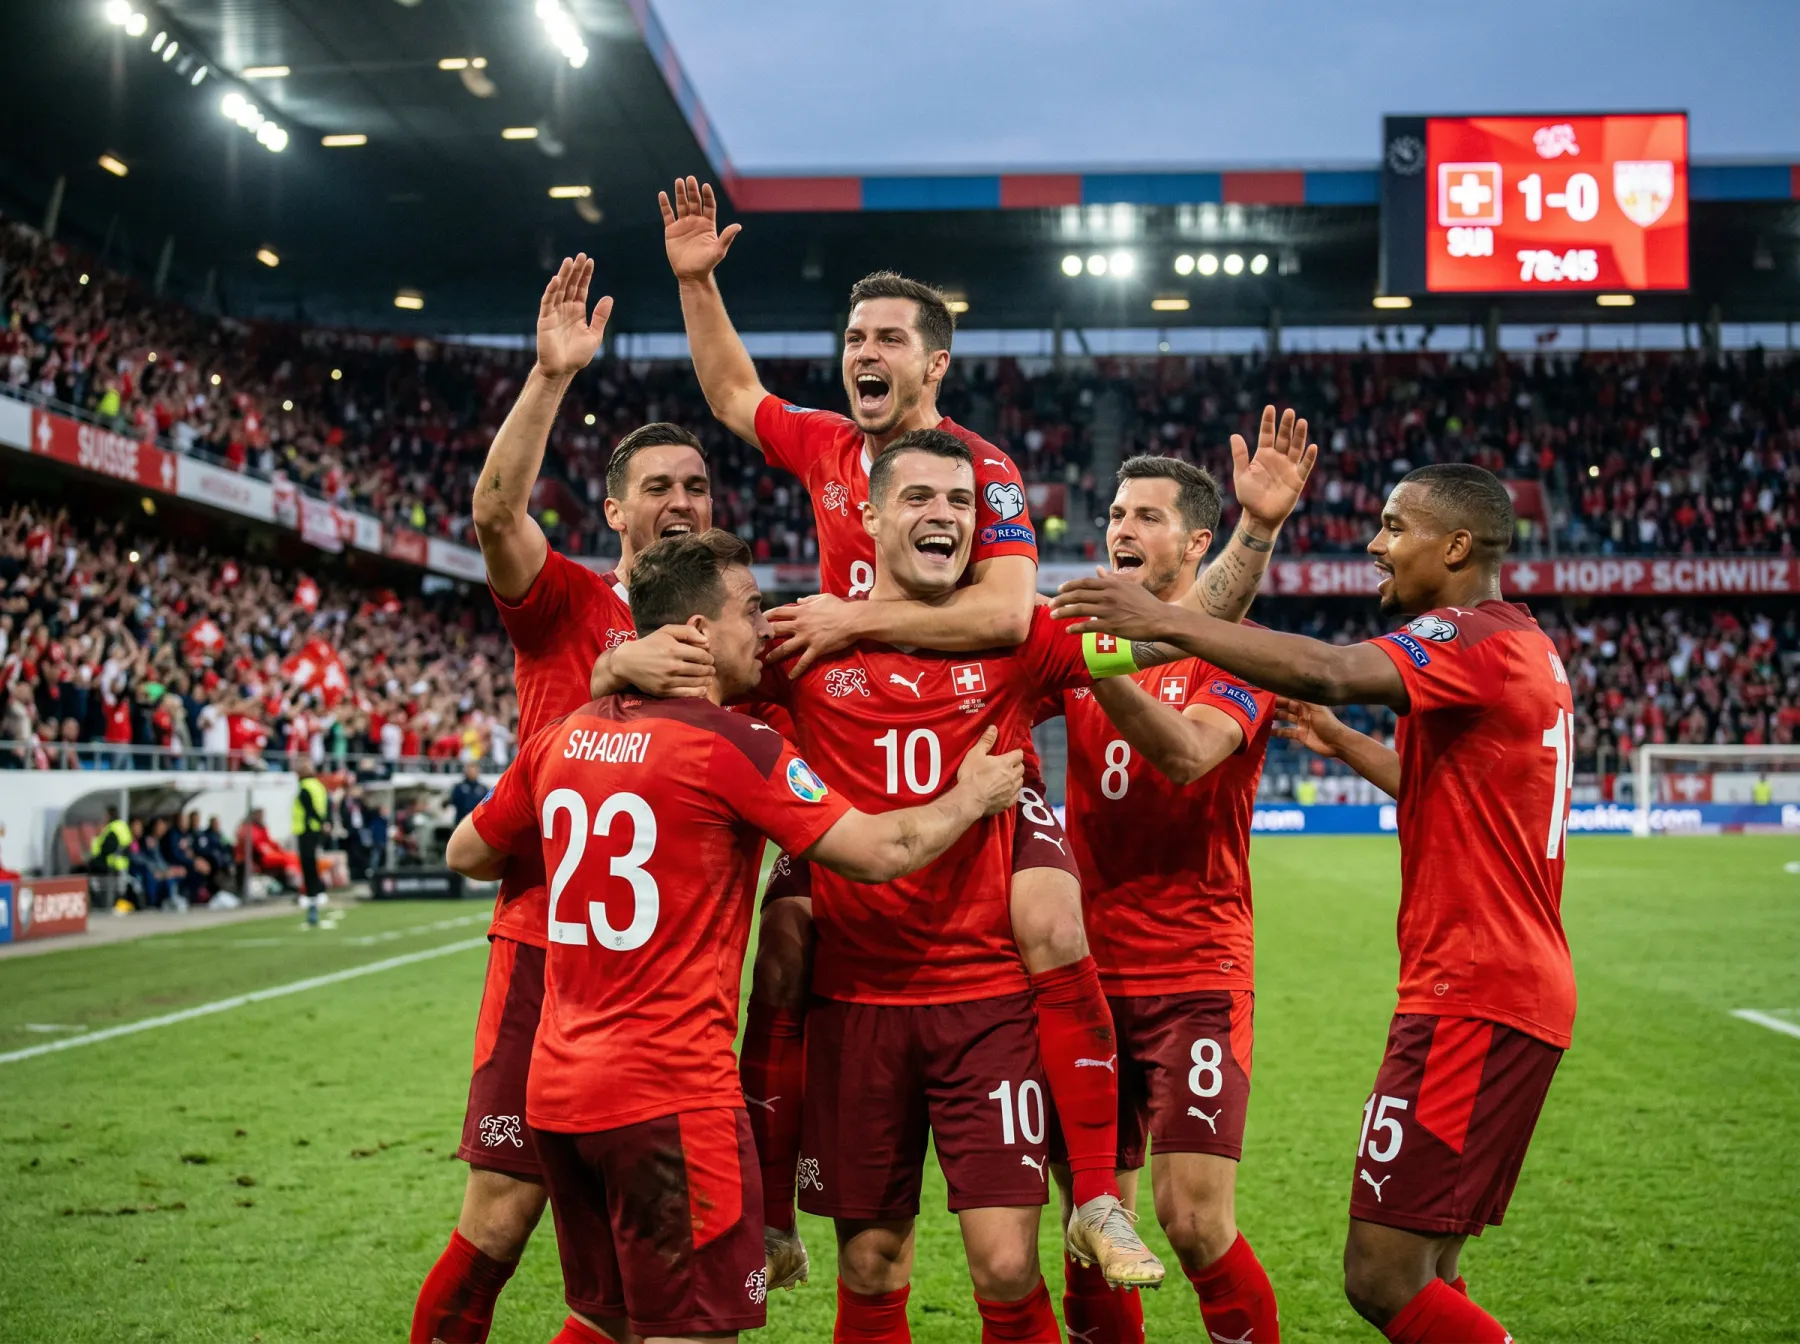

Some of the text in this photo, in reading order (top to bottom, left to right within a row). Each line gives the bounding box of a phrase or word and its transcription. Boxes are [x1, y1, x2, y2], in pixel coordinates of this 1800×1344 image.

[1517, 173, 1599, 222] 1-0
[77, 424, 139, 482] SUISSE
[1554, 560, 1645, 592] HOPP
[563, 729, 652, 764] SHAQIRI
[874, 728, 941, 794] 10
[1101, 739, 1131, 800] 8
[1018, 787, 1055, 826] 8
[542, 788, 660, 952] 23
[1187, 1038, 1223, 1098] 8
[988, 1079, 1045, 1145] 10
[1357, 1092, 1409, 1163] 15
